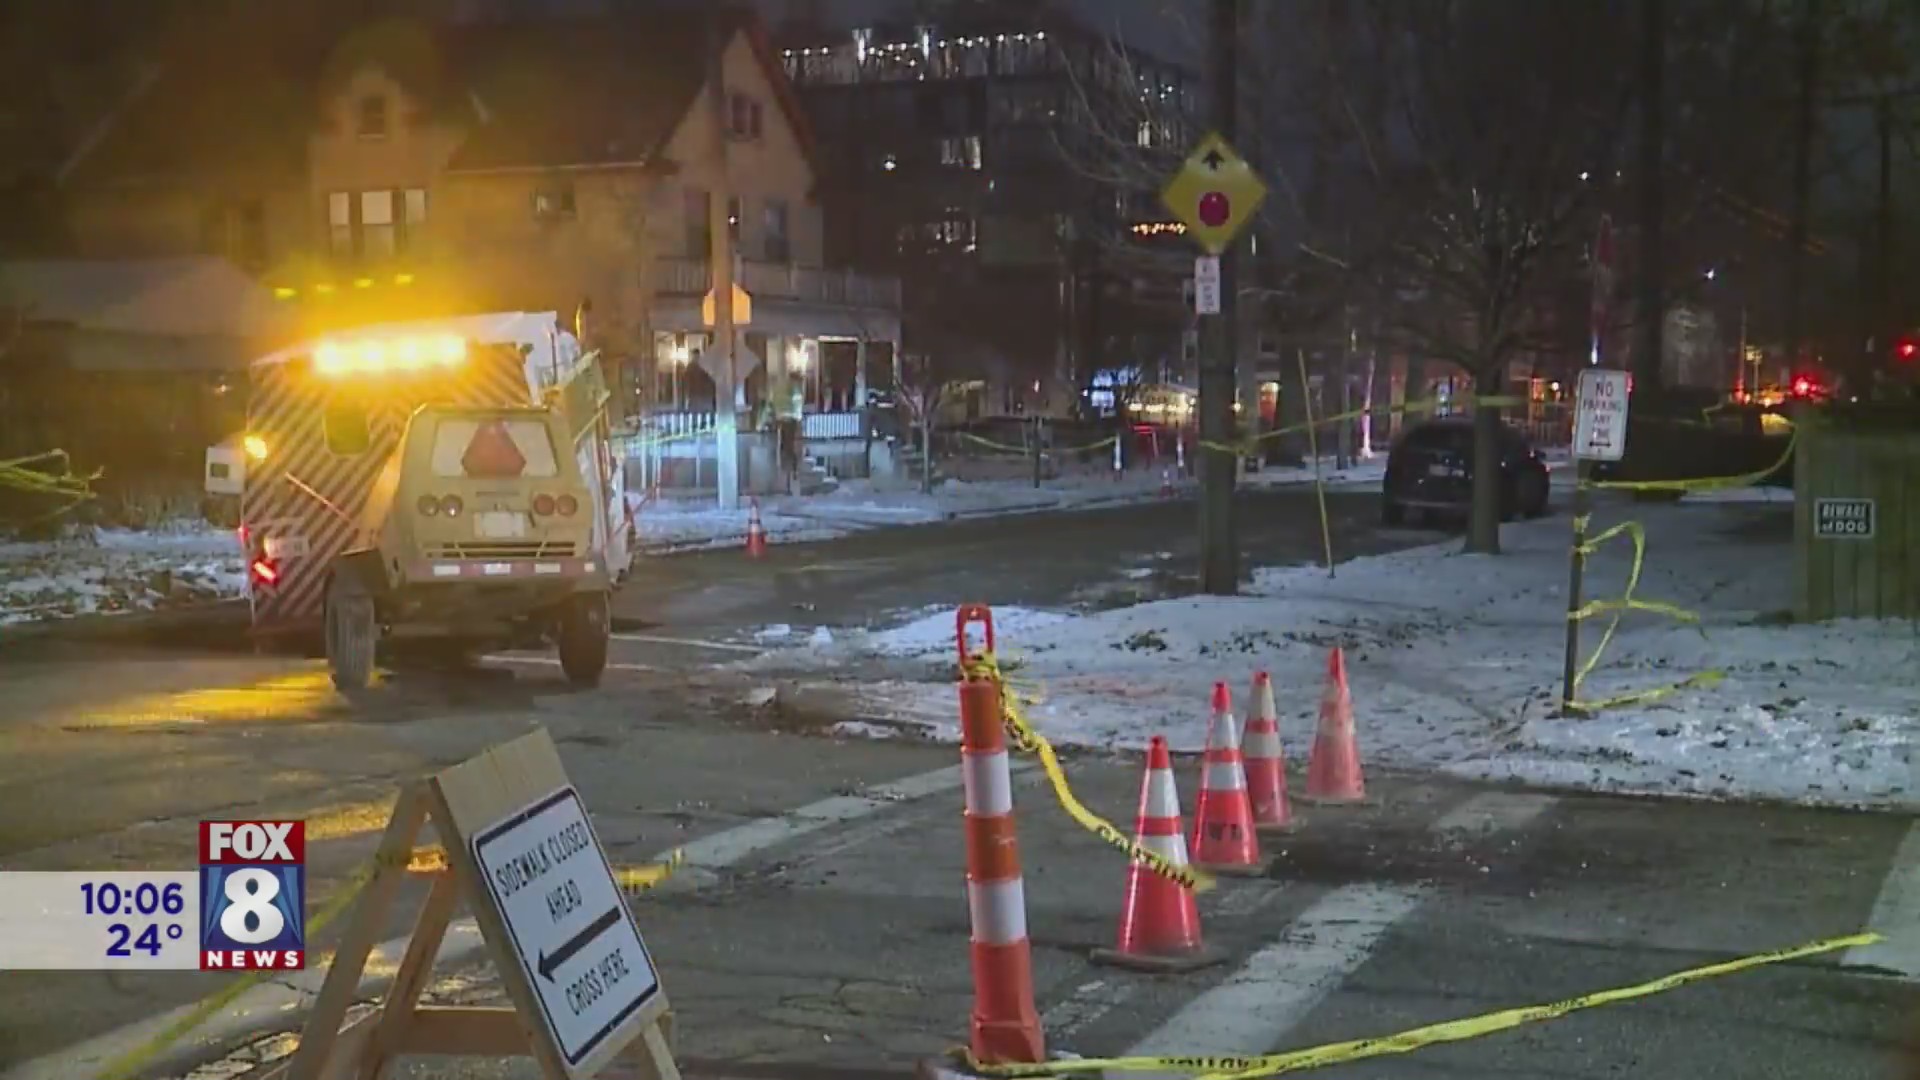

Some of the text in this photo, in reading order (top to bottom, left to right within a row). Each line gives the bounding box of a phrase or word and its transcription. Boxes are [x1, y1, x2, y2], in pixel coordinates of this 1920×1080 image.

[1595, 381, 1614, 398] NO
[1836, 520, 1867, 533] DOG
[496, 821, 589, 898] SIDEWALK CLOSED
[545, 879, 582, 924] AHEAD
[566, 947, 629, 1016] CROSS HERE
